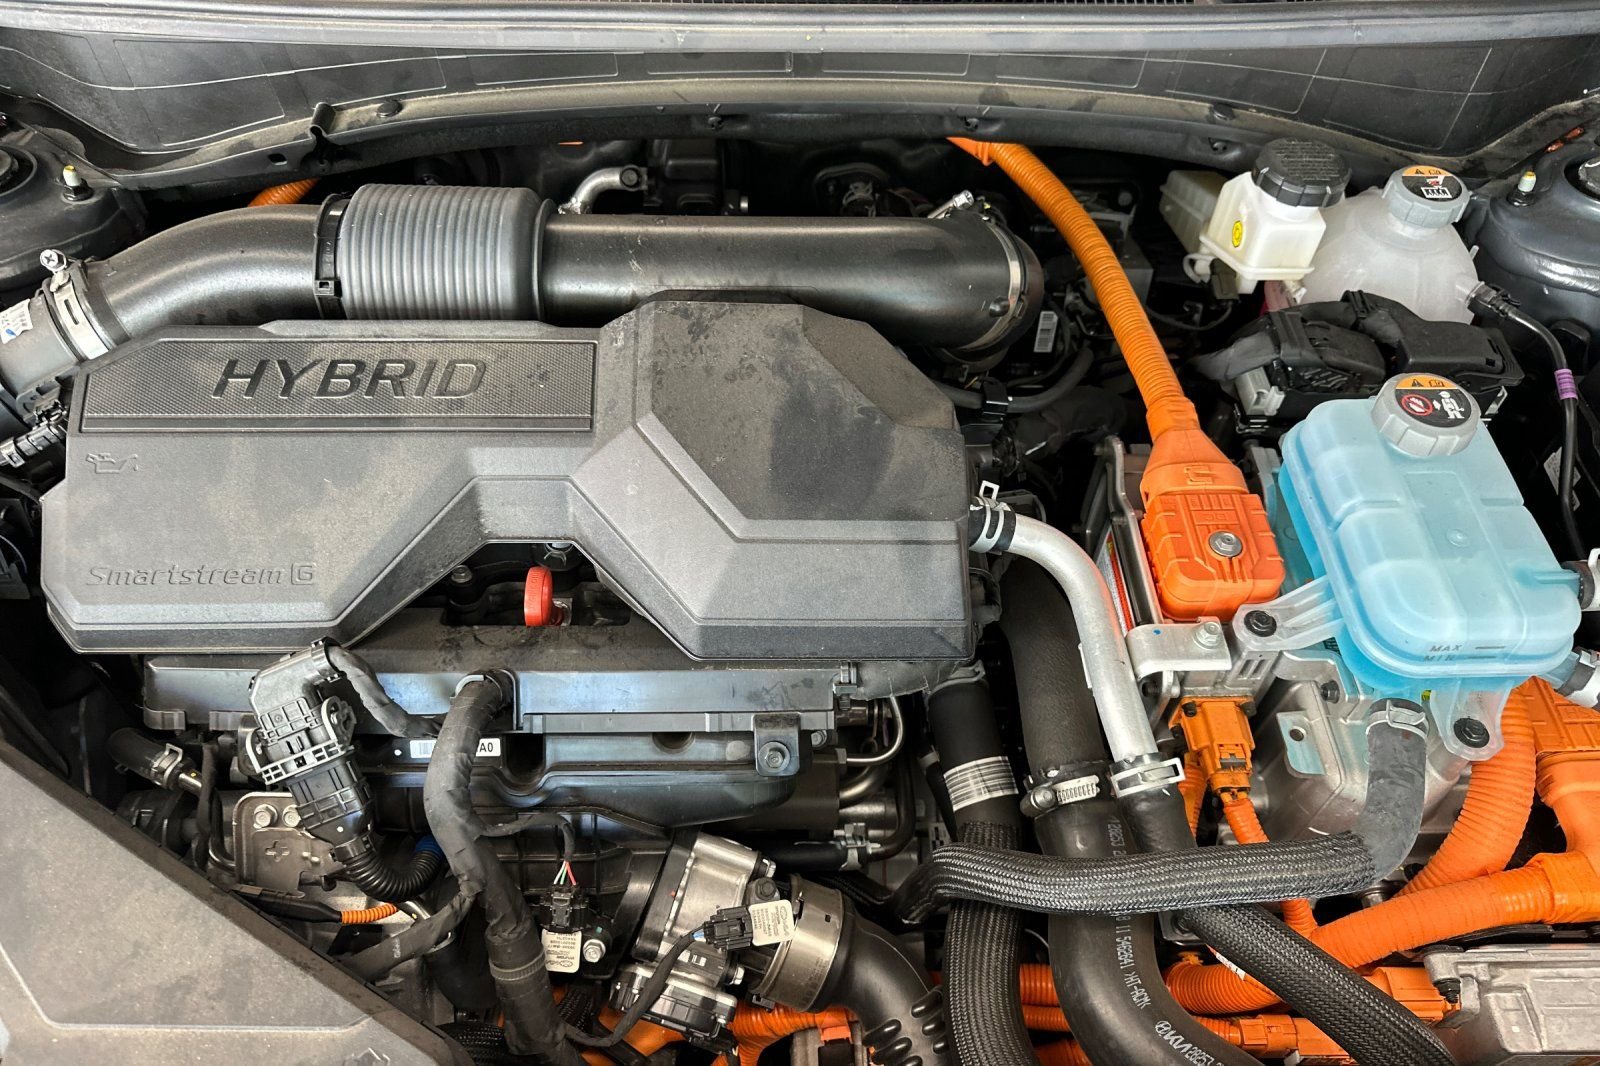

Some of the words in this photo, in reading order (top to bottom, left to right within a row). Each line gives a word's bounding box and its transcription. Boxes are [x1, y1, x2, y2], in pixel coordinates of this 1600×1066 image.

[211, 359, 486, 399] HYBRID
[86, 565, 283, 586] Smartstream
[294, 564, 313, 583] G
[1429, 644, 1462, 653] MAX
[1423, 654, 1455, 662] MIN
[479, 742, 494, 753] A0
